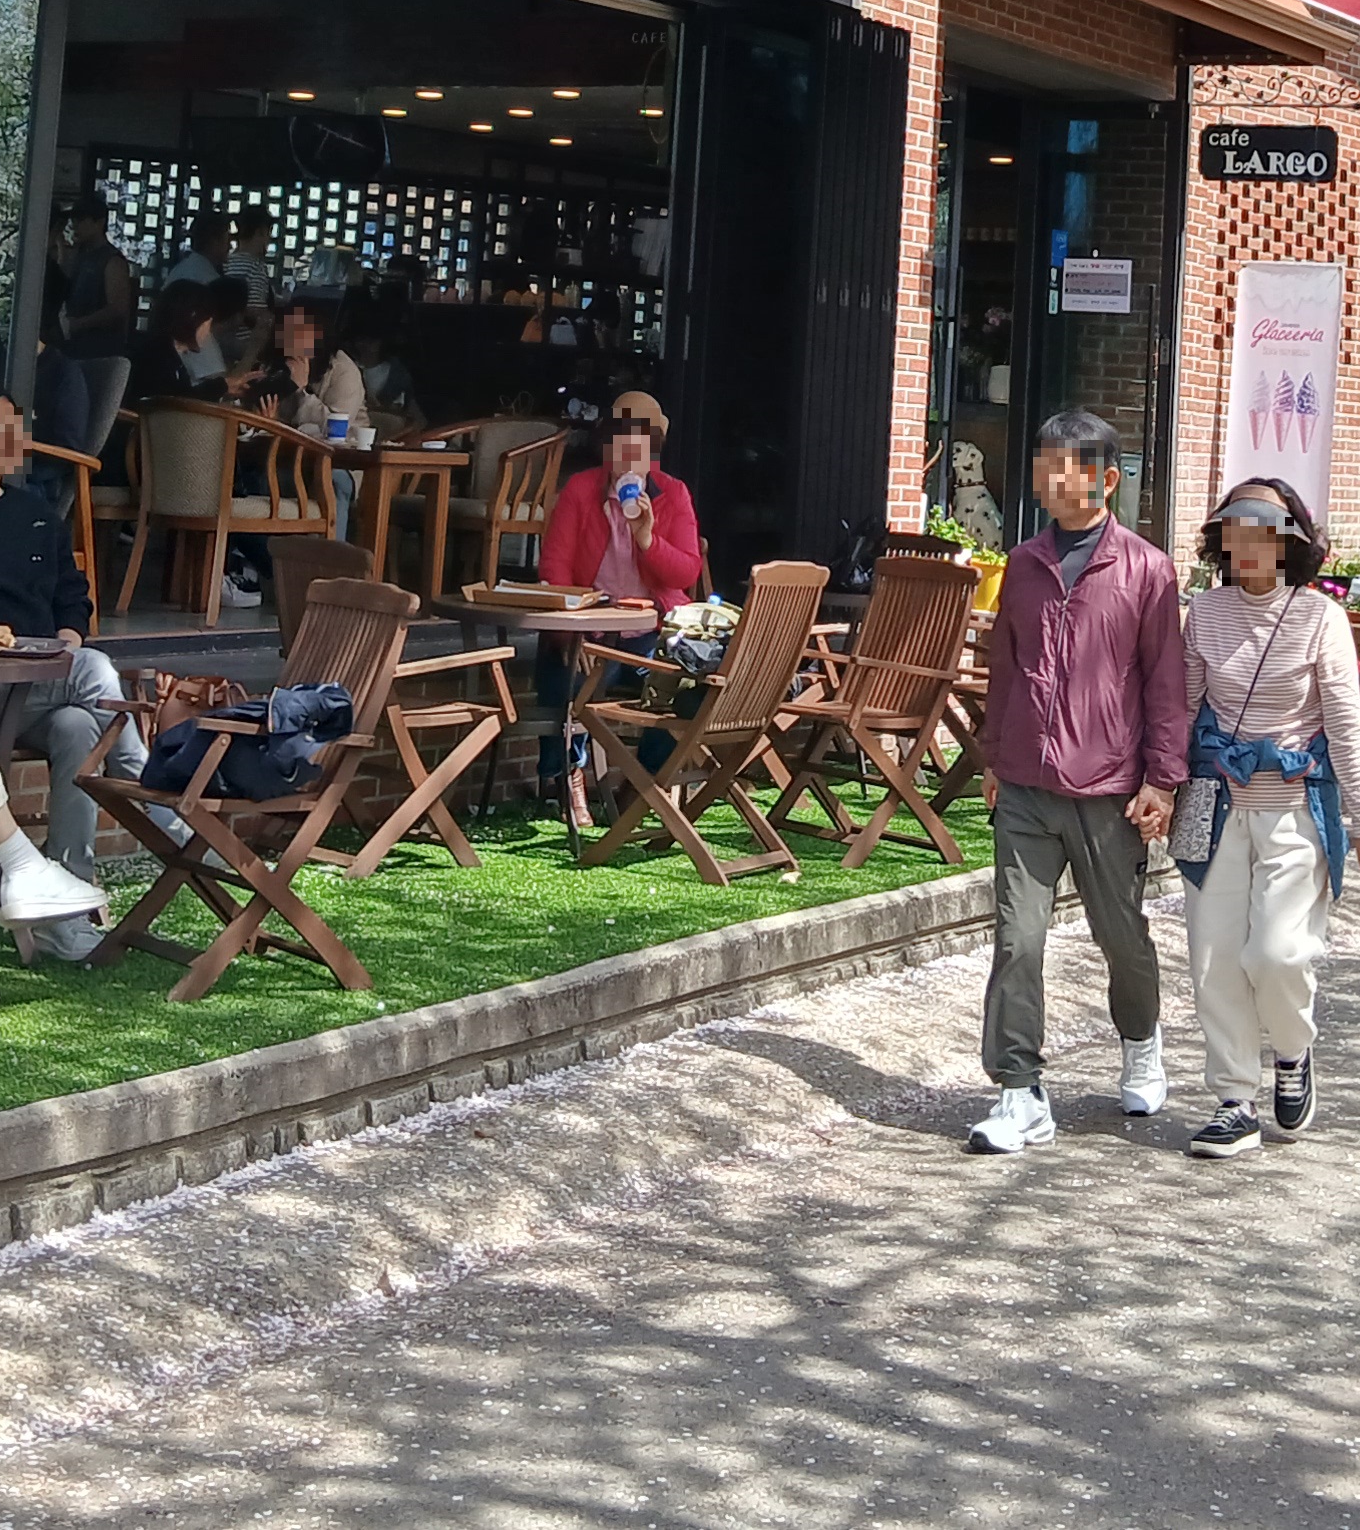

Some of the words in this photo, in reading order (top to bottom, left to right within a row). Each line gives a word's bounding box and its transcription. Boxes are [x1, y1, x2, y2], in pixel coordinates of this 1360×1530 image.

[631, 31, 666, 44] CAFE
[1208, 129, 1250, 147] cafe
[1222, 150, 1328, 177] LARGO
